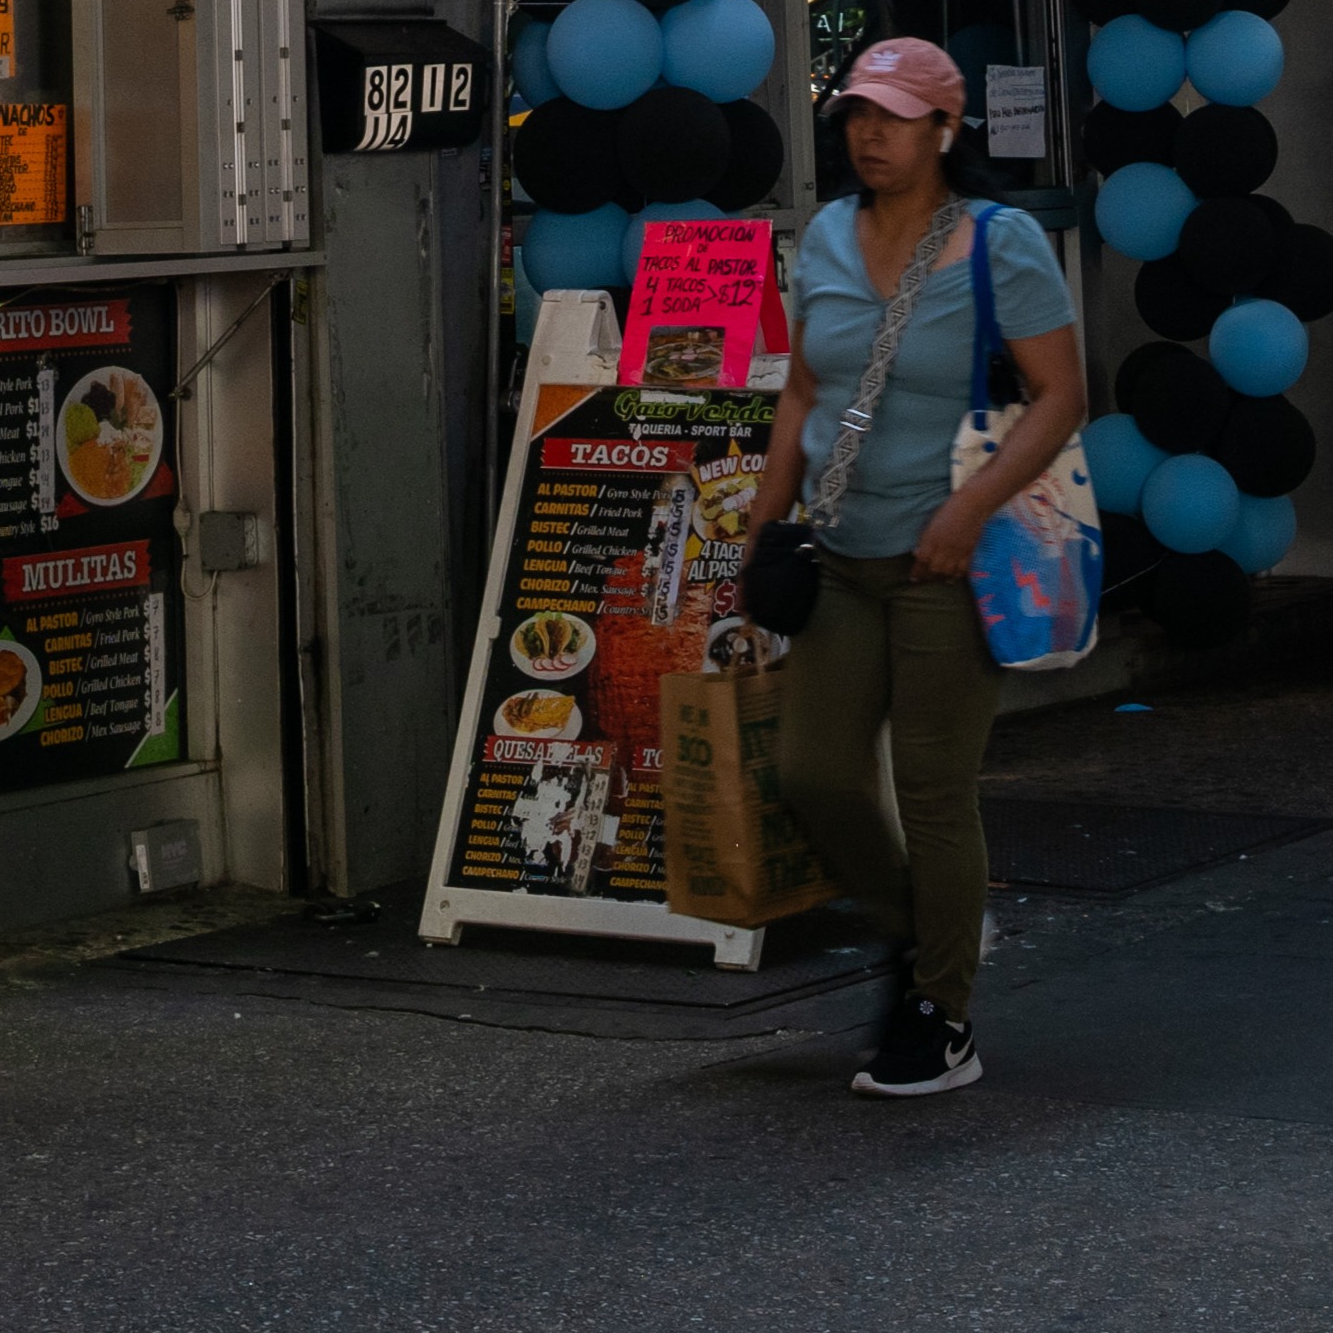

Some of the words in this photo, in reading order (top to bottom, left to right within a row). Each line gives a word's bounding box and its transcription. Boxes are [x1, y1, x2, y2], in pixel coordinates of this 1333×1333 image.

[664, 224, 757, 244] PROMOCION
[643, 256, 681, 272] TACOS
[685, 256, 701, 272] AL
[707, 258, 759, 276] PASTOR
[647, 276, 659, 294] 4
[667, 277, 707, 293] TACOS
[662, 297, 701, 314] SODA
[49, 306, 115, 337] BOWL
[629, 422, 682, 436] TAQUERIA
[690, 425, 727, 437] SPORT
[729, 425, 752, 438] BAR
[570, 443, 670, 468] TACOS
[537, 483, 551, 496] AL
[552, 484, 598, 497] PASTOR
[534, 502, 589, 516] CARNITAS
[530, 521, 570, 534] BISTEC
[527, 539, 562, 553] POLLO
[22, 550, 137, 593] MULITAS
[524, 558, 567, 573] LENGUA
[520, 578, 570, 593] CHORIZO
[517, 597, 596, 614] CAMPECHANO
[40, 611, 79, 631] PASTOR
[44, 633, 93, 653] CARNITAS
[49, 657, 83, 676] BISTEC
[42, 681, 74, 700] POLLO
[44, 703, 83, 723] LENGUA
[40, 726, 84, 747] CHORIZO
